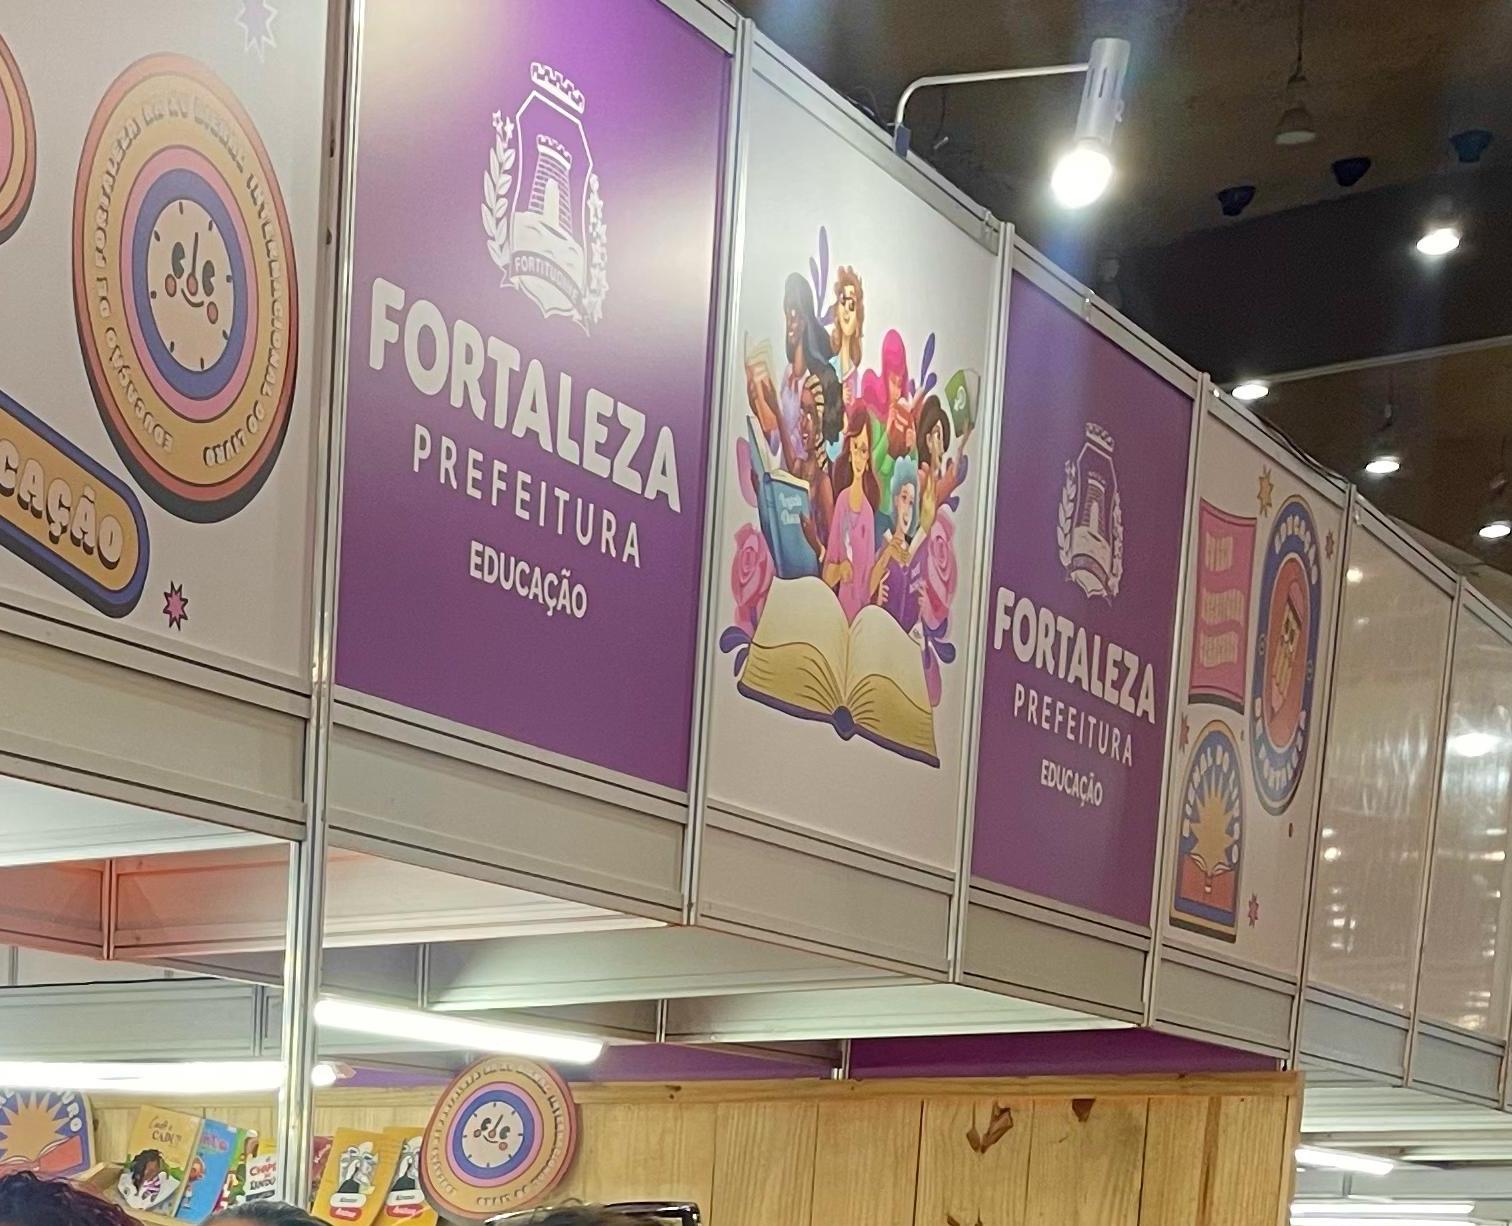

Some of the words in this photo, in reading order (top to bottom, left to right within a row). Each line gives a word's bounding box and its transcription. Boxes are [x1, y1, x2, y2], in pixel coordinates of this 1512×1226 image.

[369, 277, 681, 512] FORTALEZA
[413, 424, 641, 567] PREFEITURA
[469, 540, 587, 619] EDUCAÇÃO
[994, 587, 1155, 724] FORTALEZA
[1014, 683, 1132, 767] PREFEITURA
[1041, 758, 1102, 807] EDUCAÇÃO
